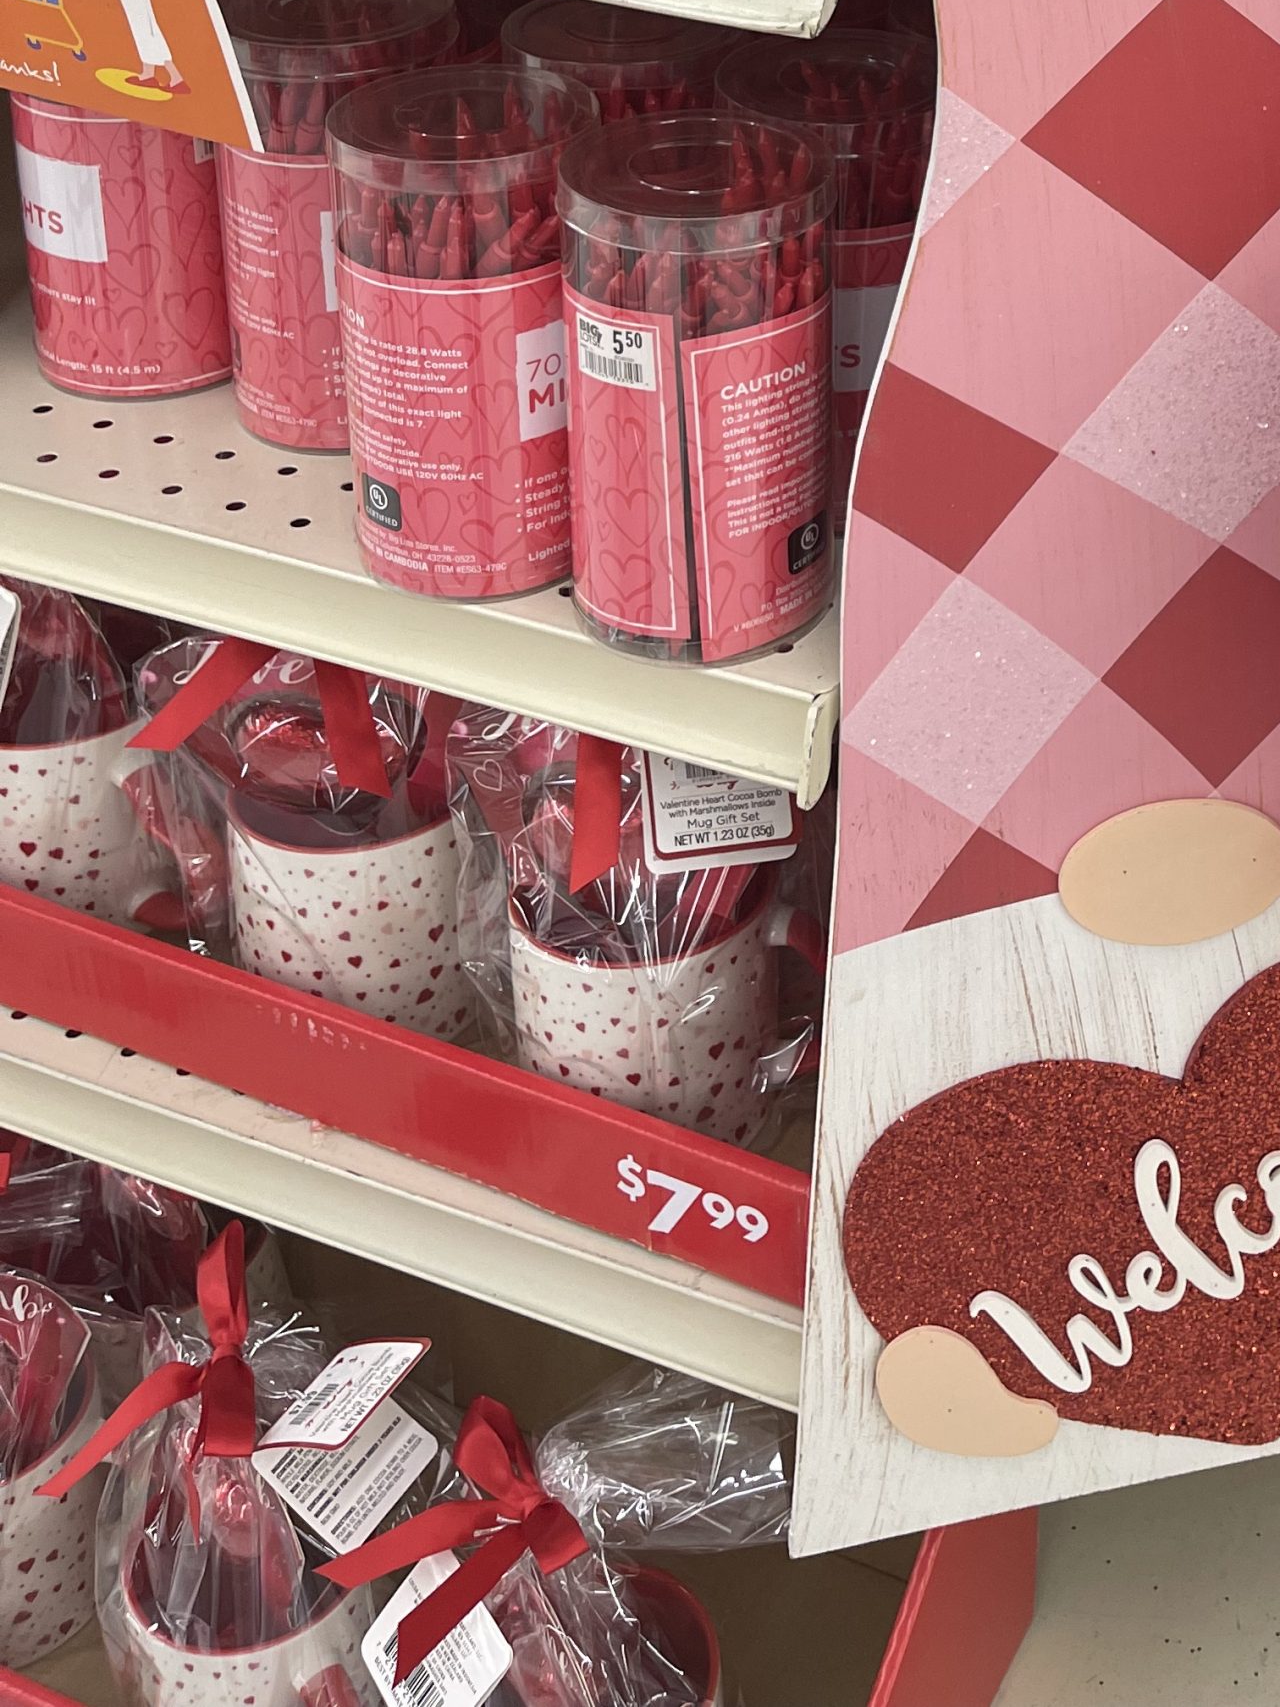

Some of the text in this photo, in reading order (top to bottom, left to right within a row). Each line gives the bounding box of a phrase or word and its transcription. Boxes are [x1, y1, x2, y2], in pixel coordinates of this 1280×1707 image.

[405, 345, 462, 358] 28.8 Watts
[392, 368, 447, 382] decorative
[423, 361, 469, 370] Connect
[526, 353, 562, 383] 70
[403, 383, 468, 394] maximum of
[720, 360, 806, 401] CAUTION
[721, 389, 783, 413] This lighting
[407, 407, 462, 419] exact light
[722, 412, 750, 427] (0.24
[722, 411, 790, 439] other lighting
[723, 436, 757, 451] outfits
[421, 460, 463, 472] use only.
[469, 472, 484, 480] AC
[524, 483, 566, 504] Steady
[525, 499, 562, 519] String
[526, 521, 549, 533] For
[527, 539, 570, 563] Lighted
[659, 788, 783, 811] Valentine Heart Cocoa Bomb
[668, 798, 776, 819] with Marshmallows Inside
[687, 811, 761, 830] Mug Gift Set
[674, 823, 775, 847] NET WT 1.23 OZ (35g)
[369, 1655, 391, 1678] BEST
